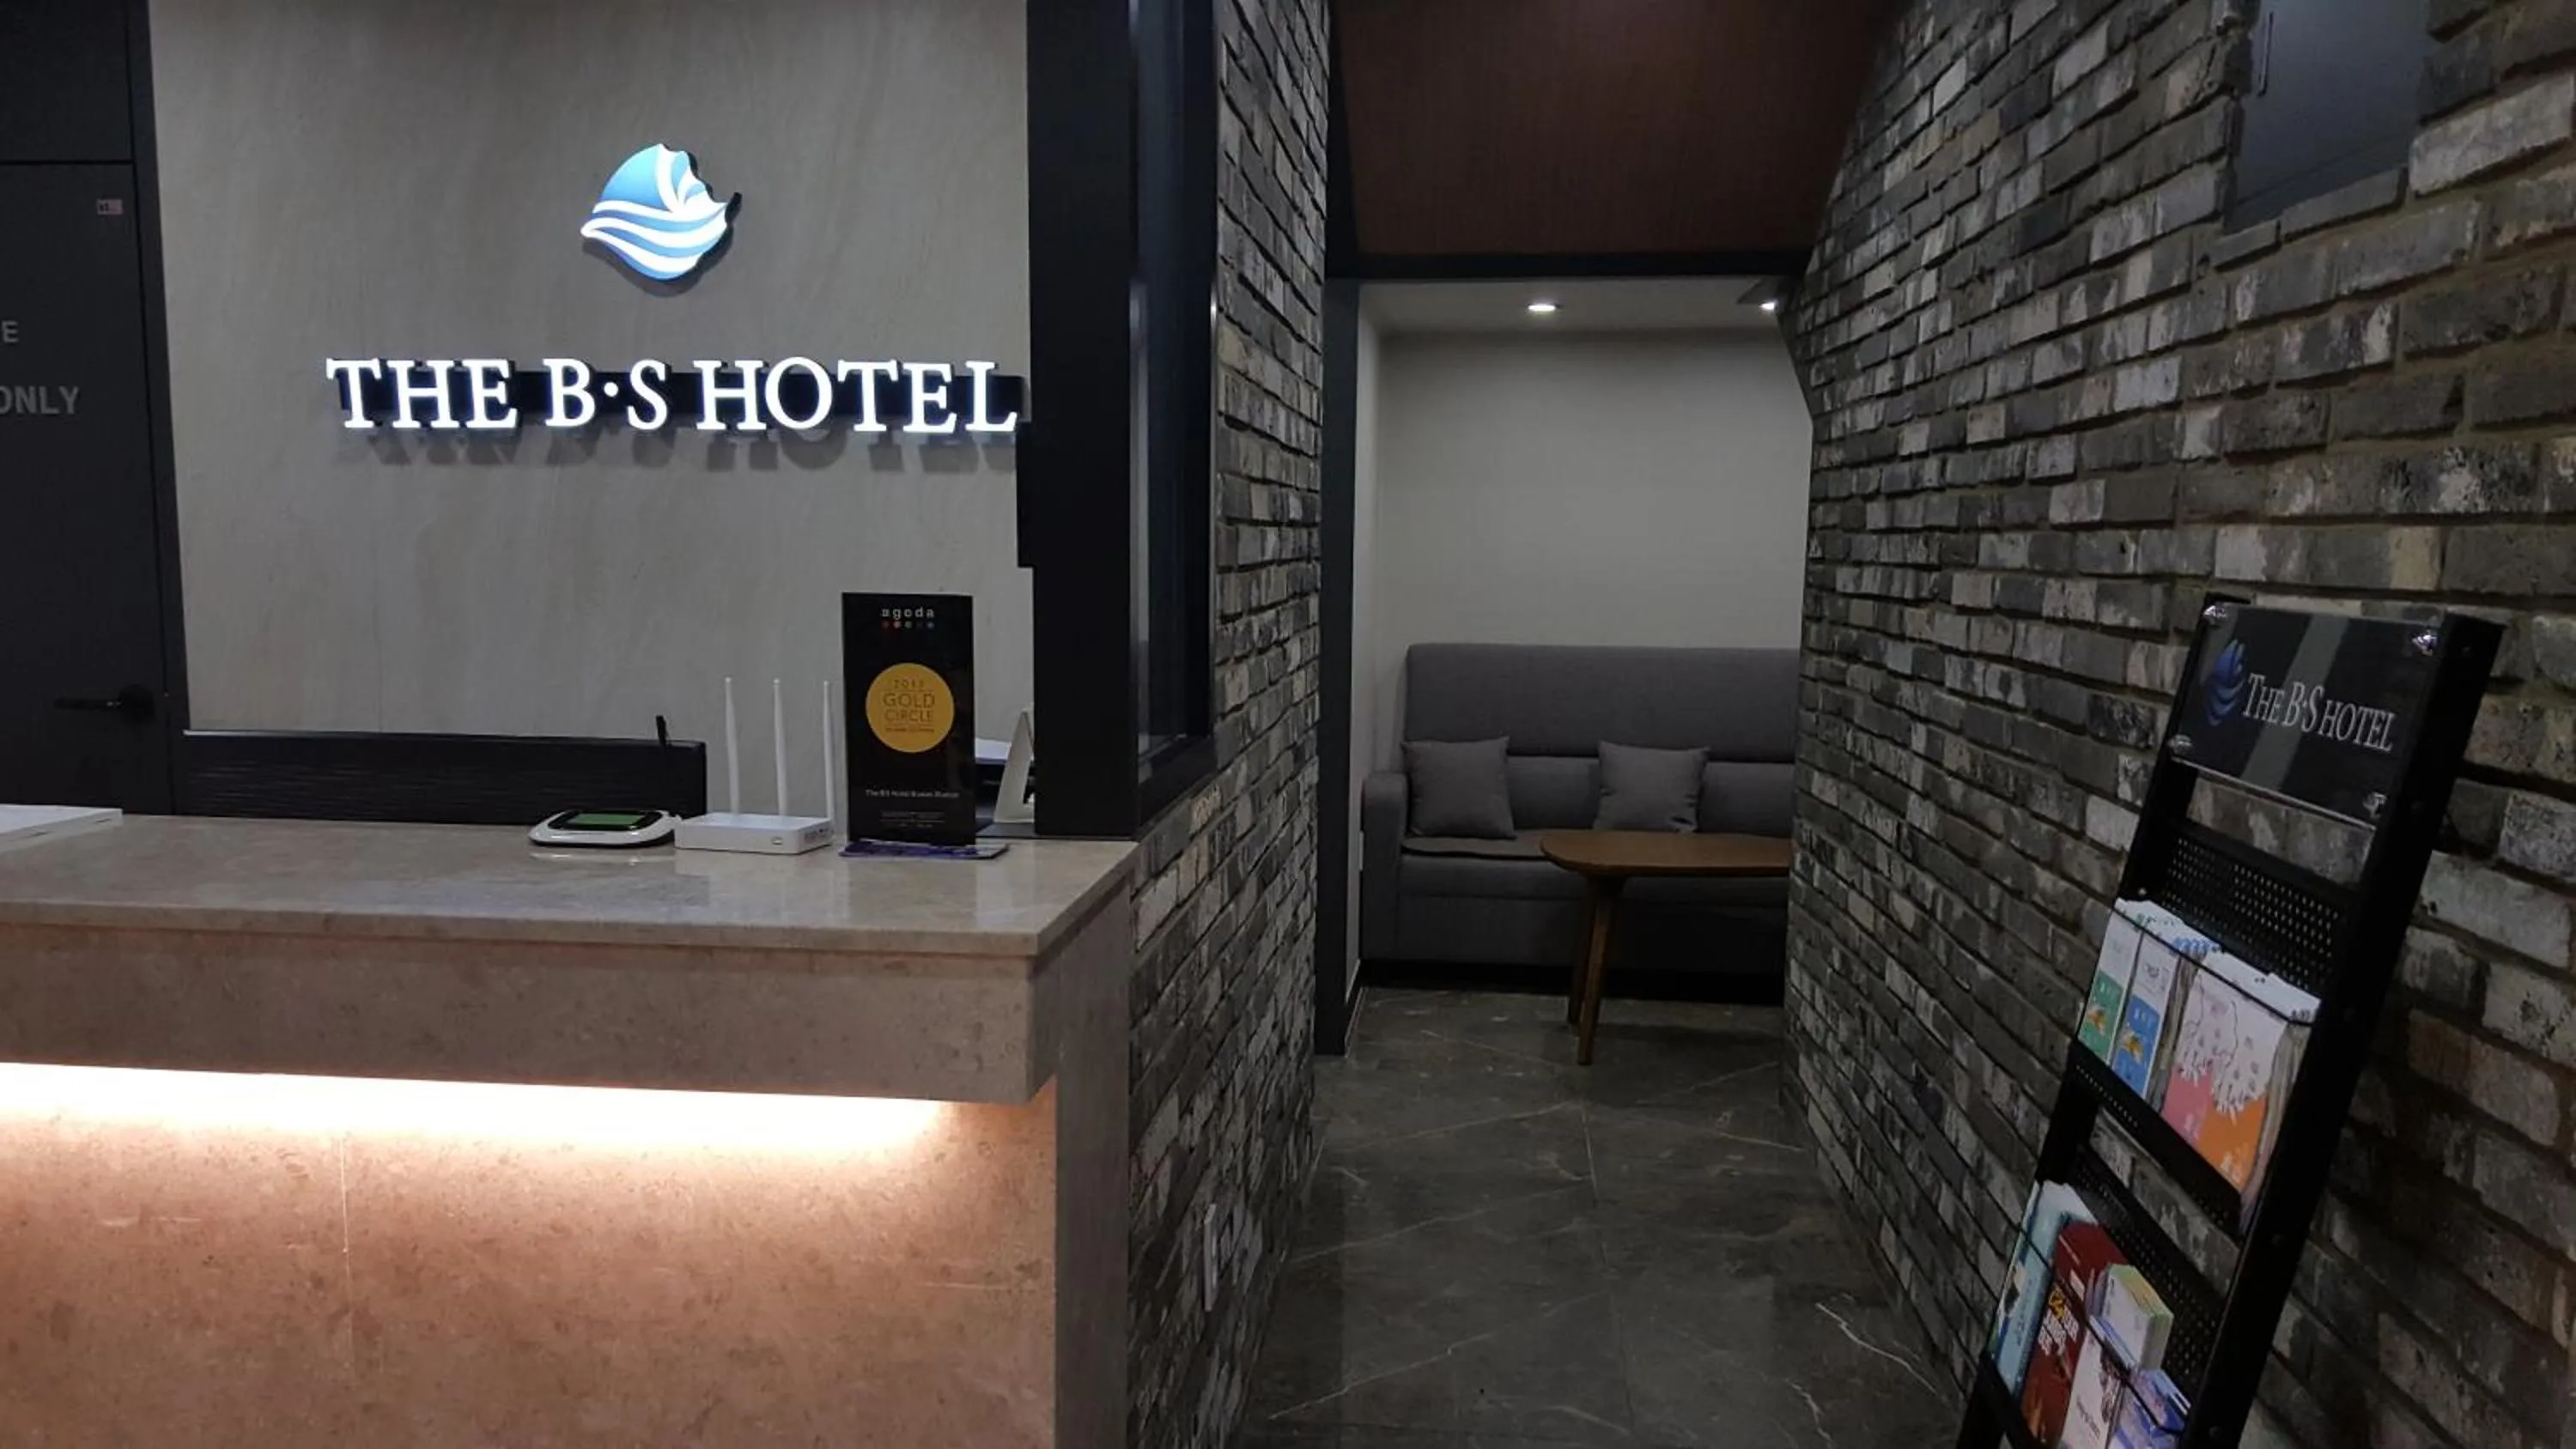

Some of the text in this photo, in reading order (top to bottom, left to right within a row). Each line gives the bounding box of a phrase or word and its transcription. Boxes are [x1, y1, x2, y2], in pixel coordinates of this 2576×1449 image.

[325, 357, 518, 429] THE
[692, 355, 1018, 434] HOTEL
[881, 606, 935, 620] agoda
[883, 692, 935, 708] GOLD
[884, 708, 934, 723] CIRCLE
[2318, 699, 2397, 753] HOTEL
